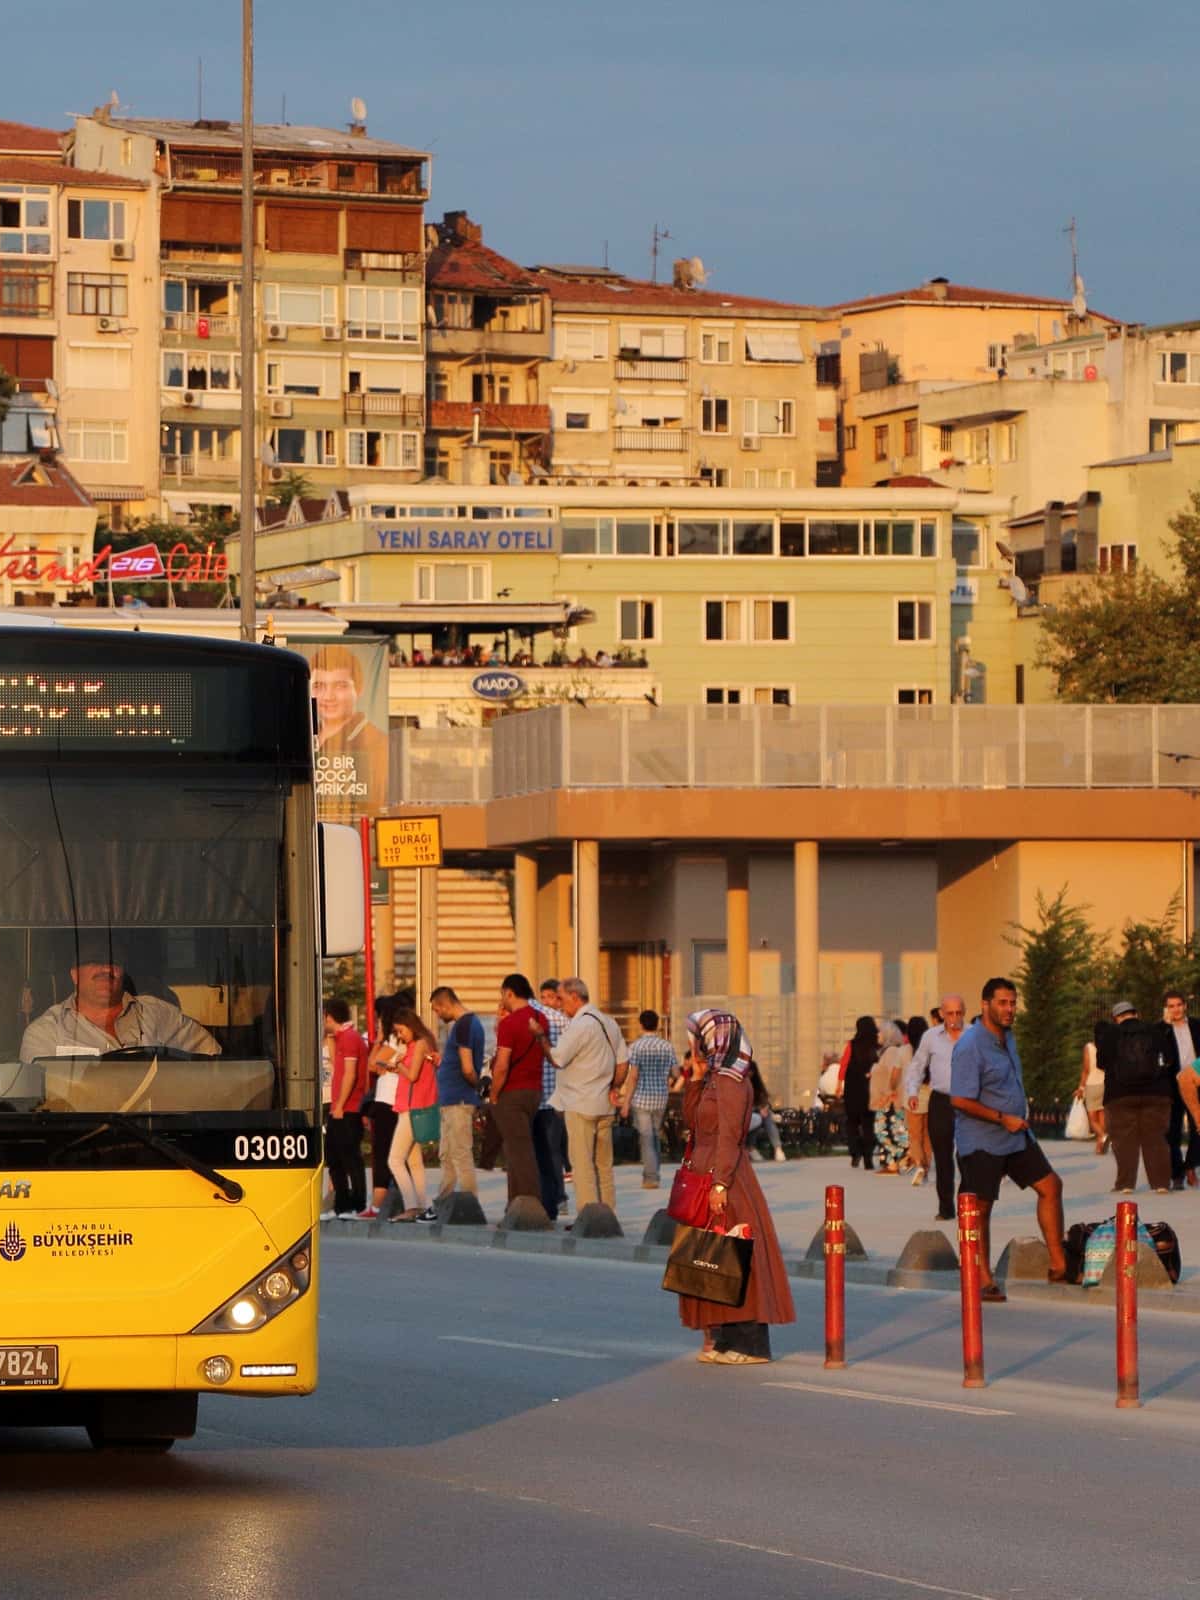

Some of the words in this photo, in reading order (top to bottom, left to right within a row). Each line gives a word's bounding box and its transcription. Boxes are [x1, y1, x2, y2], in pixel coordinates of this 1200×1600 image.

[377, 526, 421, 549] YENİ
[428, 530, 491, 549] SARAY
[497, 527, 553, 549] OTELİ
[112, 557, 157, 571] 216
[166, 541, 229, 583] Cafe
[477, 677, 519, 691] MADO
[234, 1134, 308, 1161] 03080
[33, 1230, 134, 1250] BÜYÜKŞEHİR
